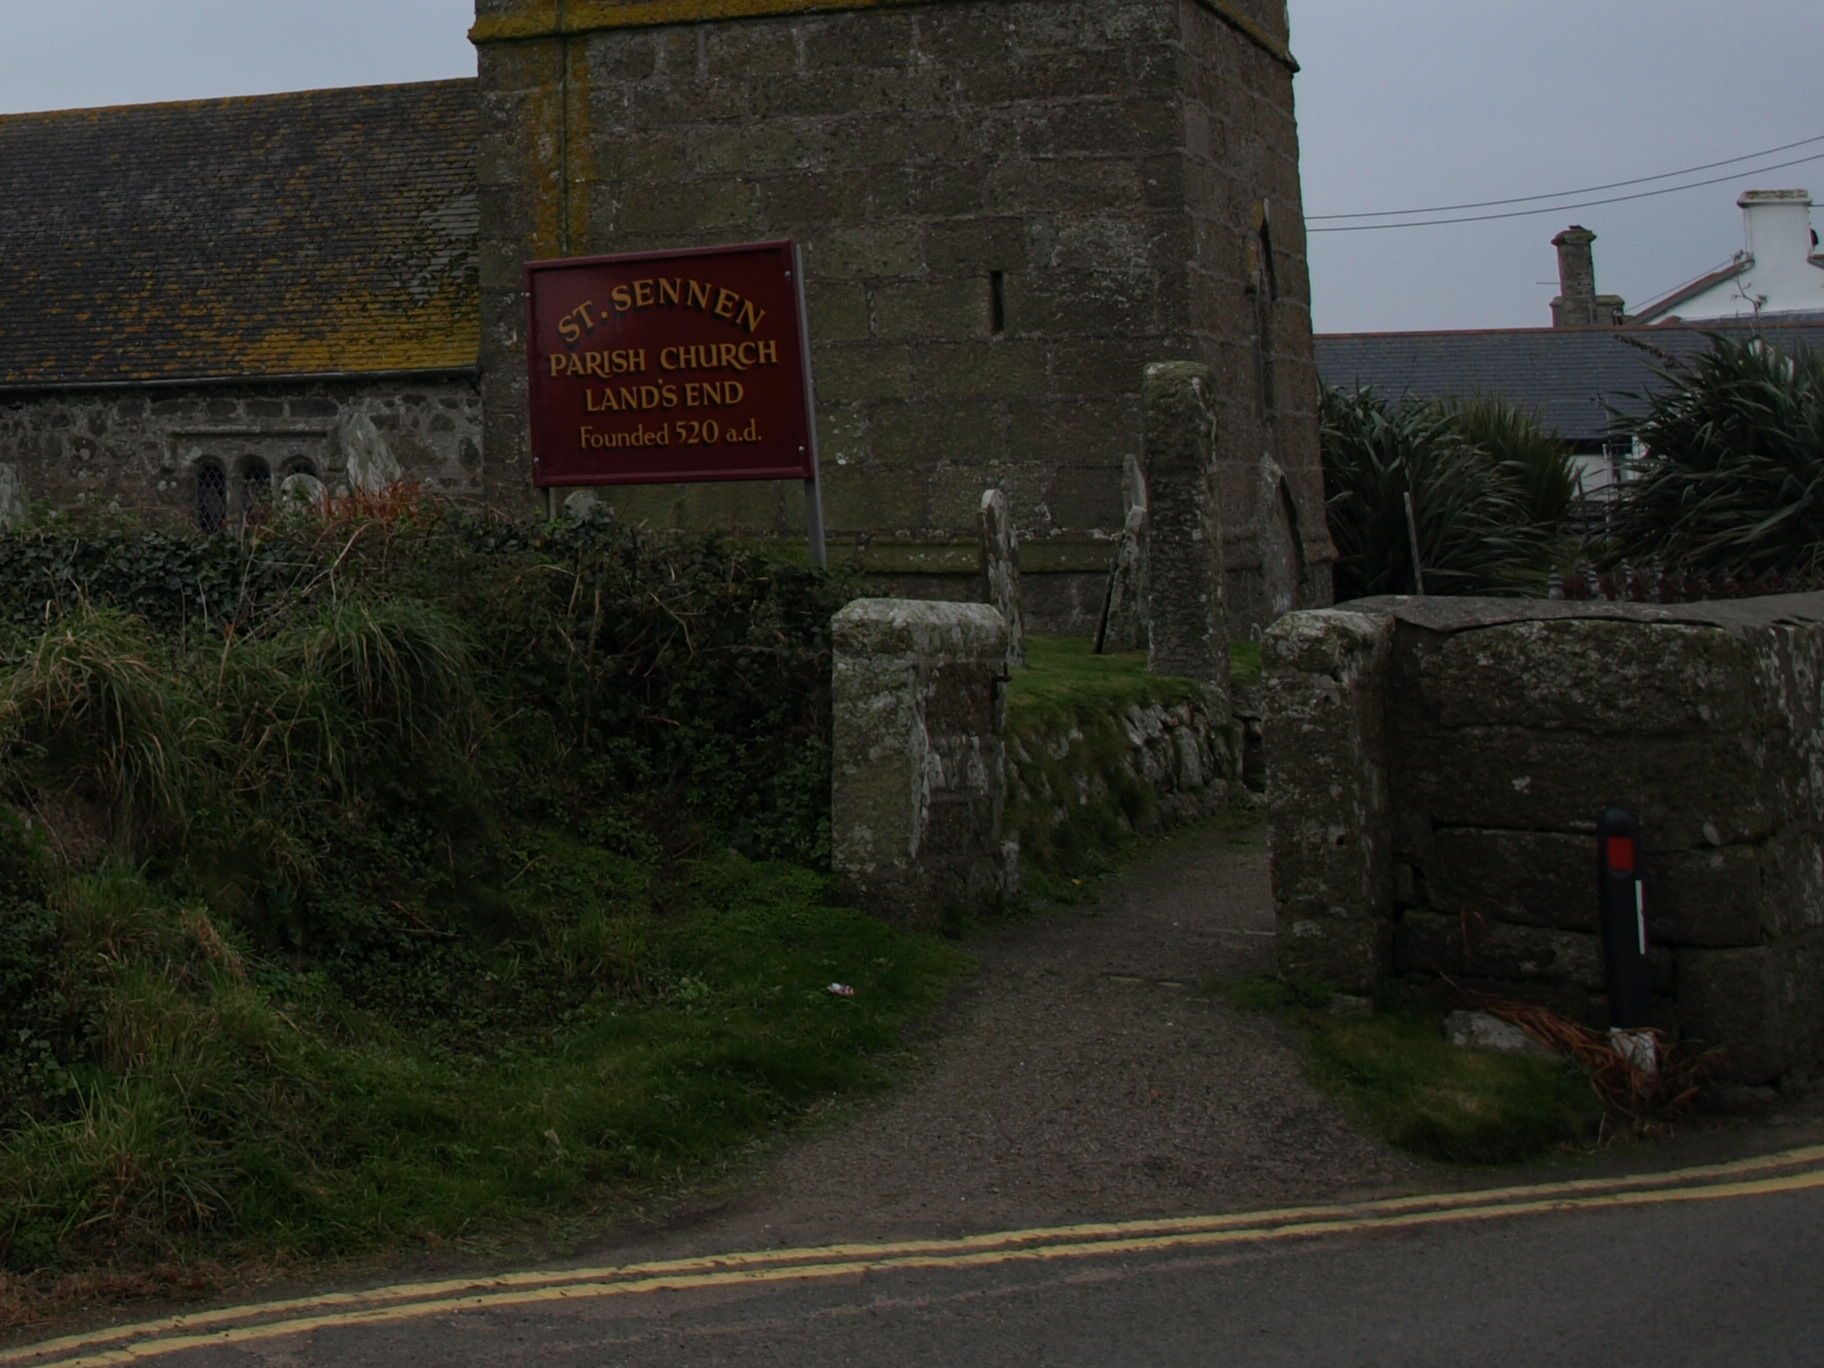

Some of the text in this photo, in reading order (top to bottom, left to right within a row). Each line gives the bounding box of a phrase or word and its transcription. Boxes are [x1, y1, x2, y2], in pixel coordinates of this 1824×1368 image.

[611, 278, 767, 333] SENNEN
[549, 340, 778, 378] PARISH CHURCH
[686, 381, 744, 407] END
[579, 418, 763, 449] Founded 520 a.d.
